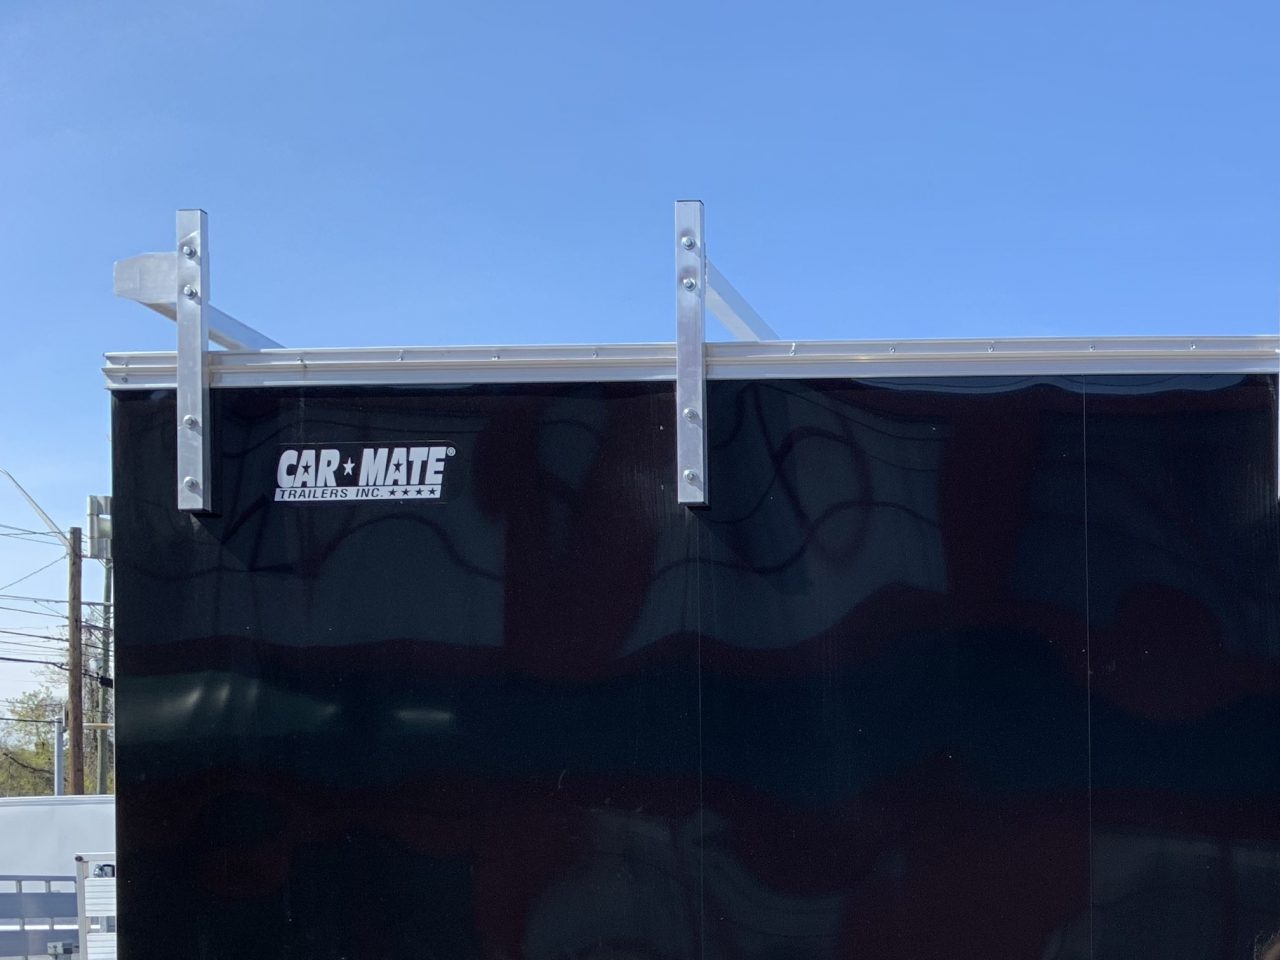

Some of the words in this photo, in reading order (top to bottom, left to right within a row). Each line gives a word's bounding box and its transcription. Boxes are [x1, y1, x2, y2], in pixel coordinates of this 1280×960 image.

[277, 449, 340, 488] CAR
[280, 488, 348, 499] TRAILERS
[355, 487, 384, 498] INC.
